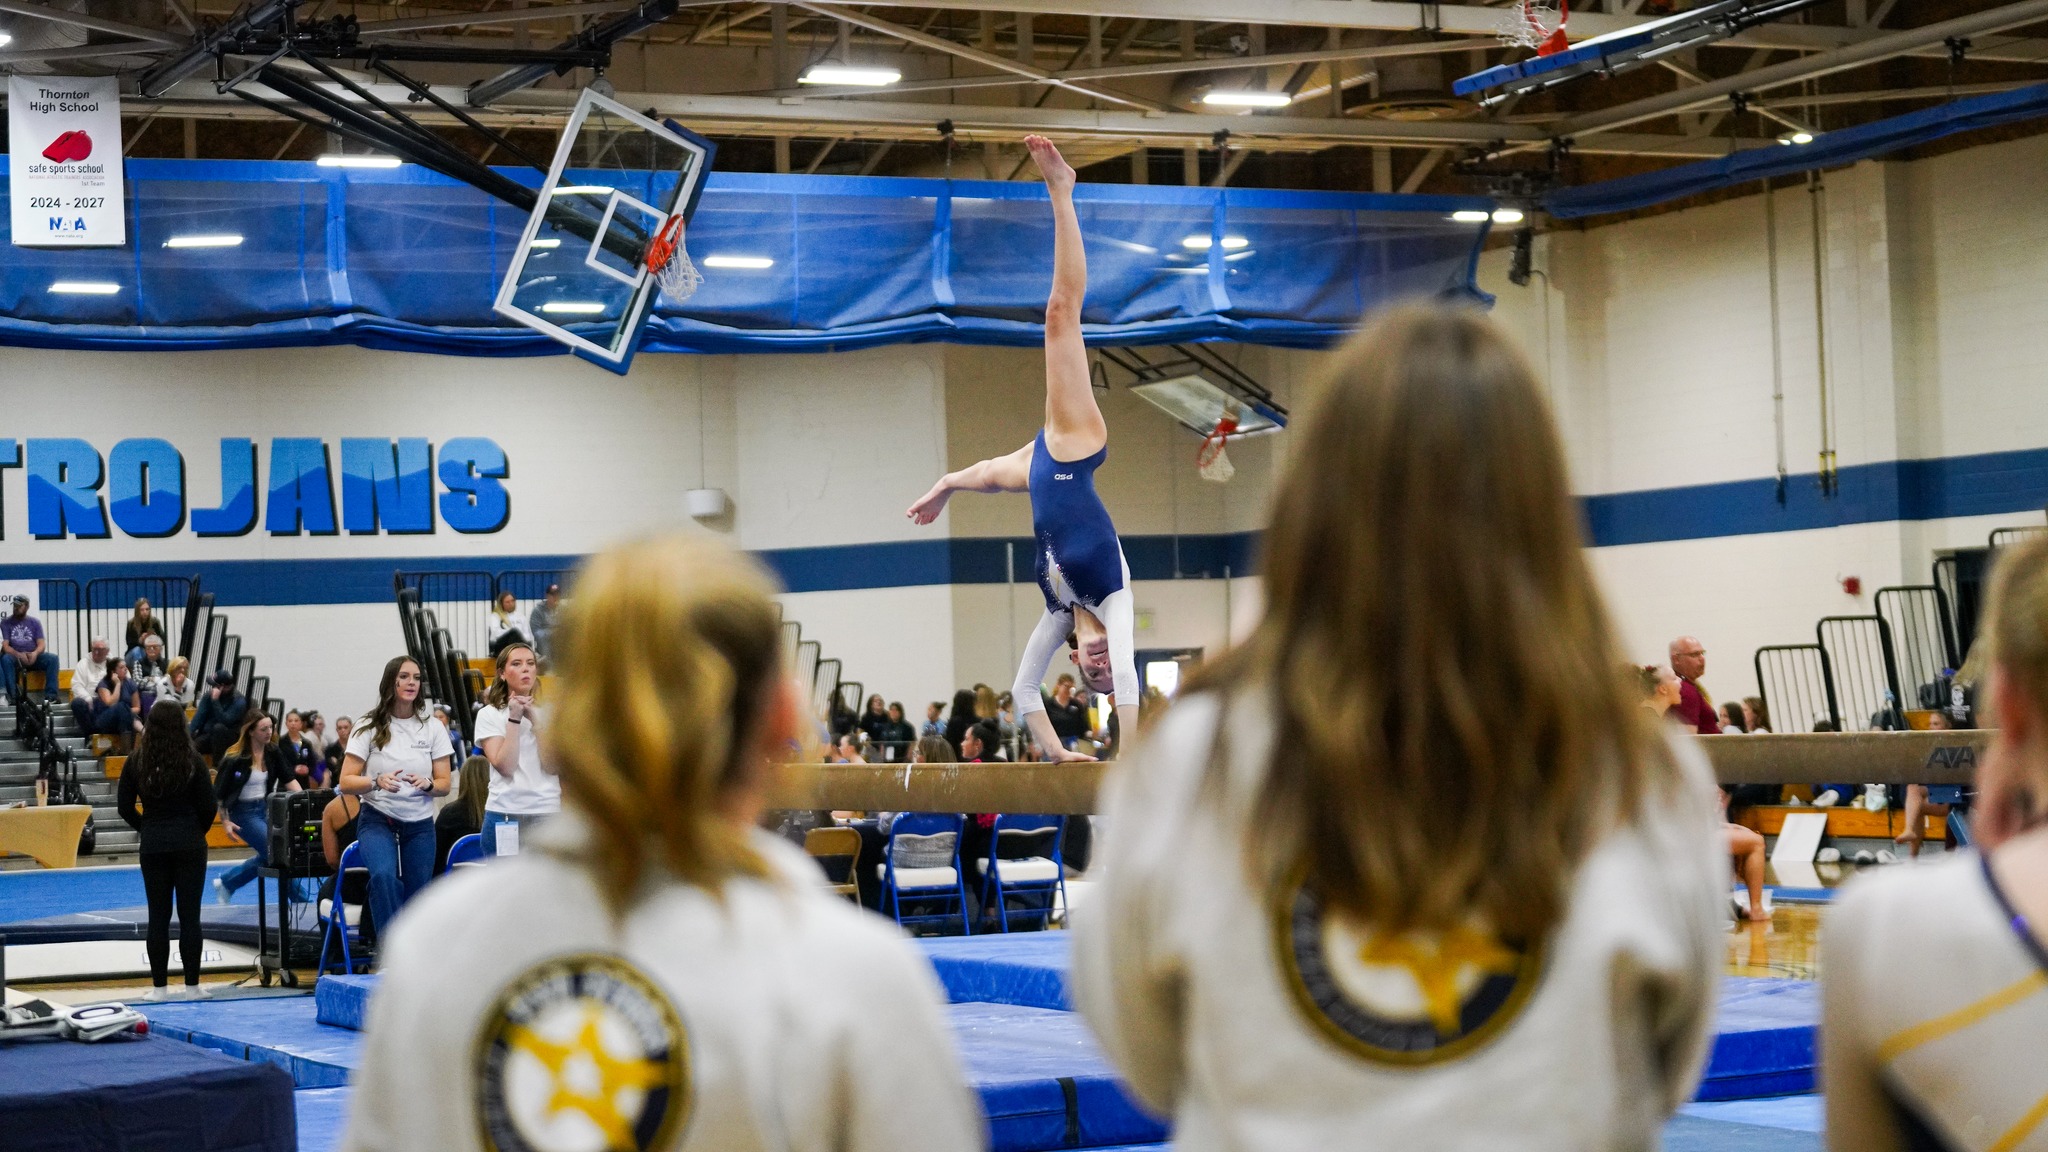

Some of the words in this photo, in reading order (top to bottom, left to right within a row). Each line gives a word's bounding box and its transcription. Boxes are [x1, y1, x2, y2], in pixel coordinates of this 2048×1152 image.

[39, 89, 90, 99] Thornton
[30, 102, 56, 113] High
[60, 102, 99, 112] School
[28, 163, 47, 173] safe
[49, 163, 76, 175] sports
[77, 163, 104, 173] school
[30, 197, 61, 208] 2024
[74, 197, 105, 208] 2027
[0, 436, 510, 540] ROJANS
